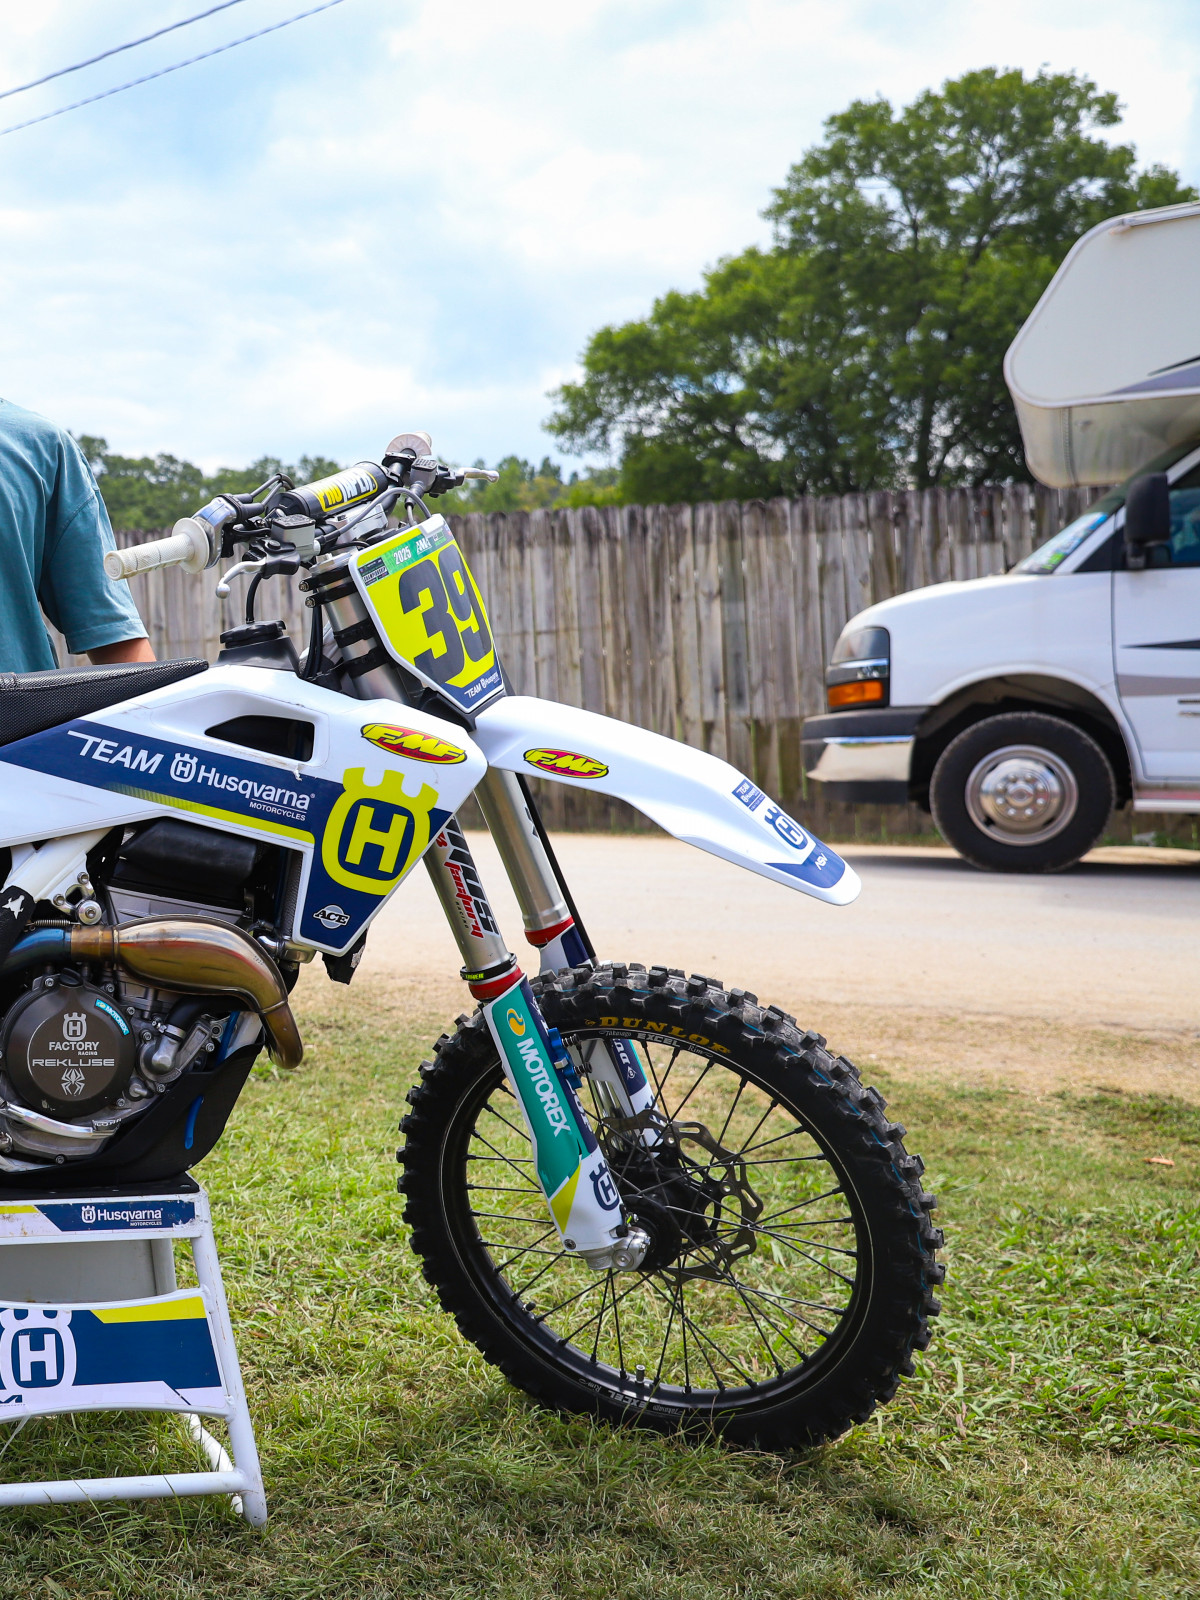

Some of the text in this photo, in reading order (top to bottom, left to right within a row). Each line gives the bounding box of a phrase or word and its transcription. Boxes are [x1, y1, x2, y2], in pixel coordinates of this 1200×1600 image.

[393, 546, 412, 565] 2025
[398, 543, 494, 685] 39
[464, 683, 482, 698] TEAM
[362, 725, 465, 758] FMF
[68, 730, 164, 774] TEAM
[198, 767, 310, 810] Husqvarna
[524, 750, 608, 773] FMF
[249, 802, 306, 821] MOTORCYCLES
[315, 909, 349, 926] ACE
[106, 1006, 128, 1033] MOTOREX
[600, 1017, 731, 1053] DUNLOP
[637, 1033, 680, 1047] EXCEL
[49, 1042, 99, 1050] FACTORY
[516, 1037, 571, 1137] MOTOREX
[98, 1209, 161, 1221] Husqvarna
[608, 1390, 647, 1408] EXCEL
